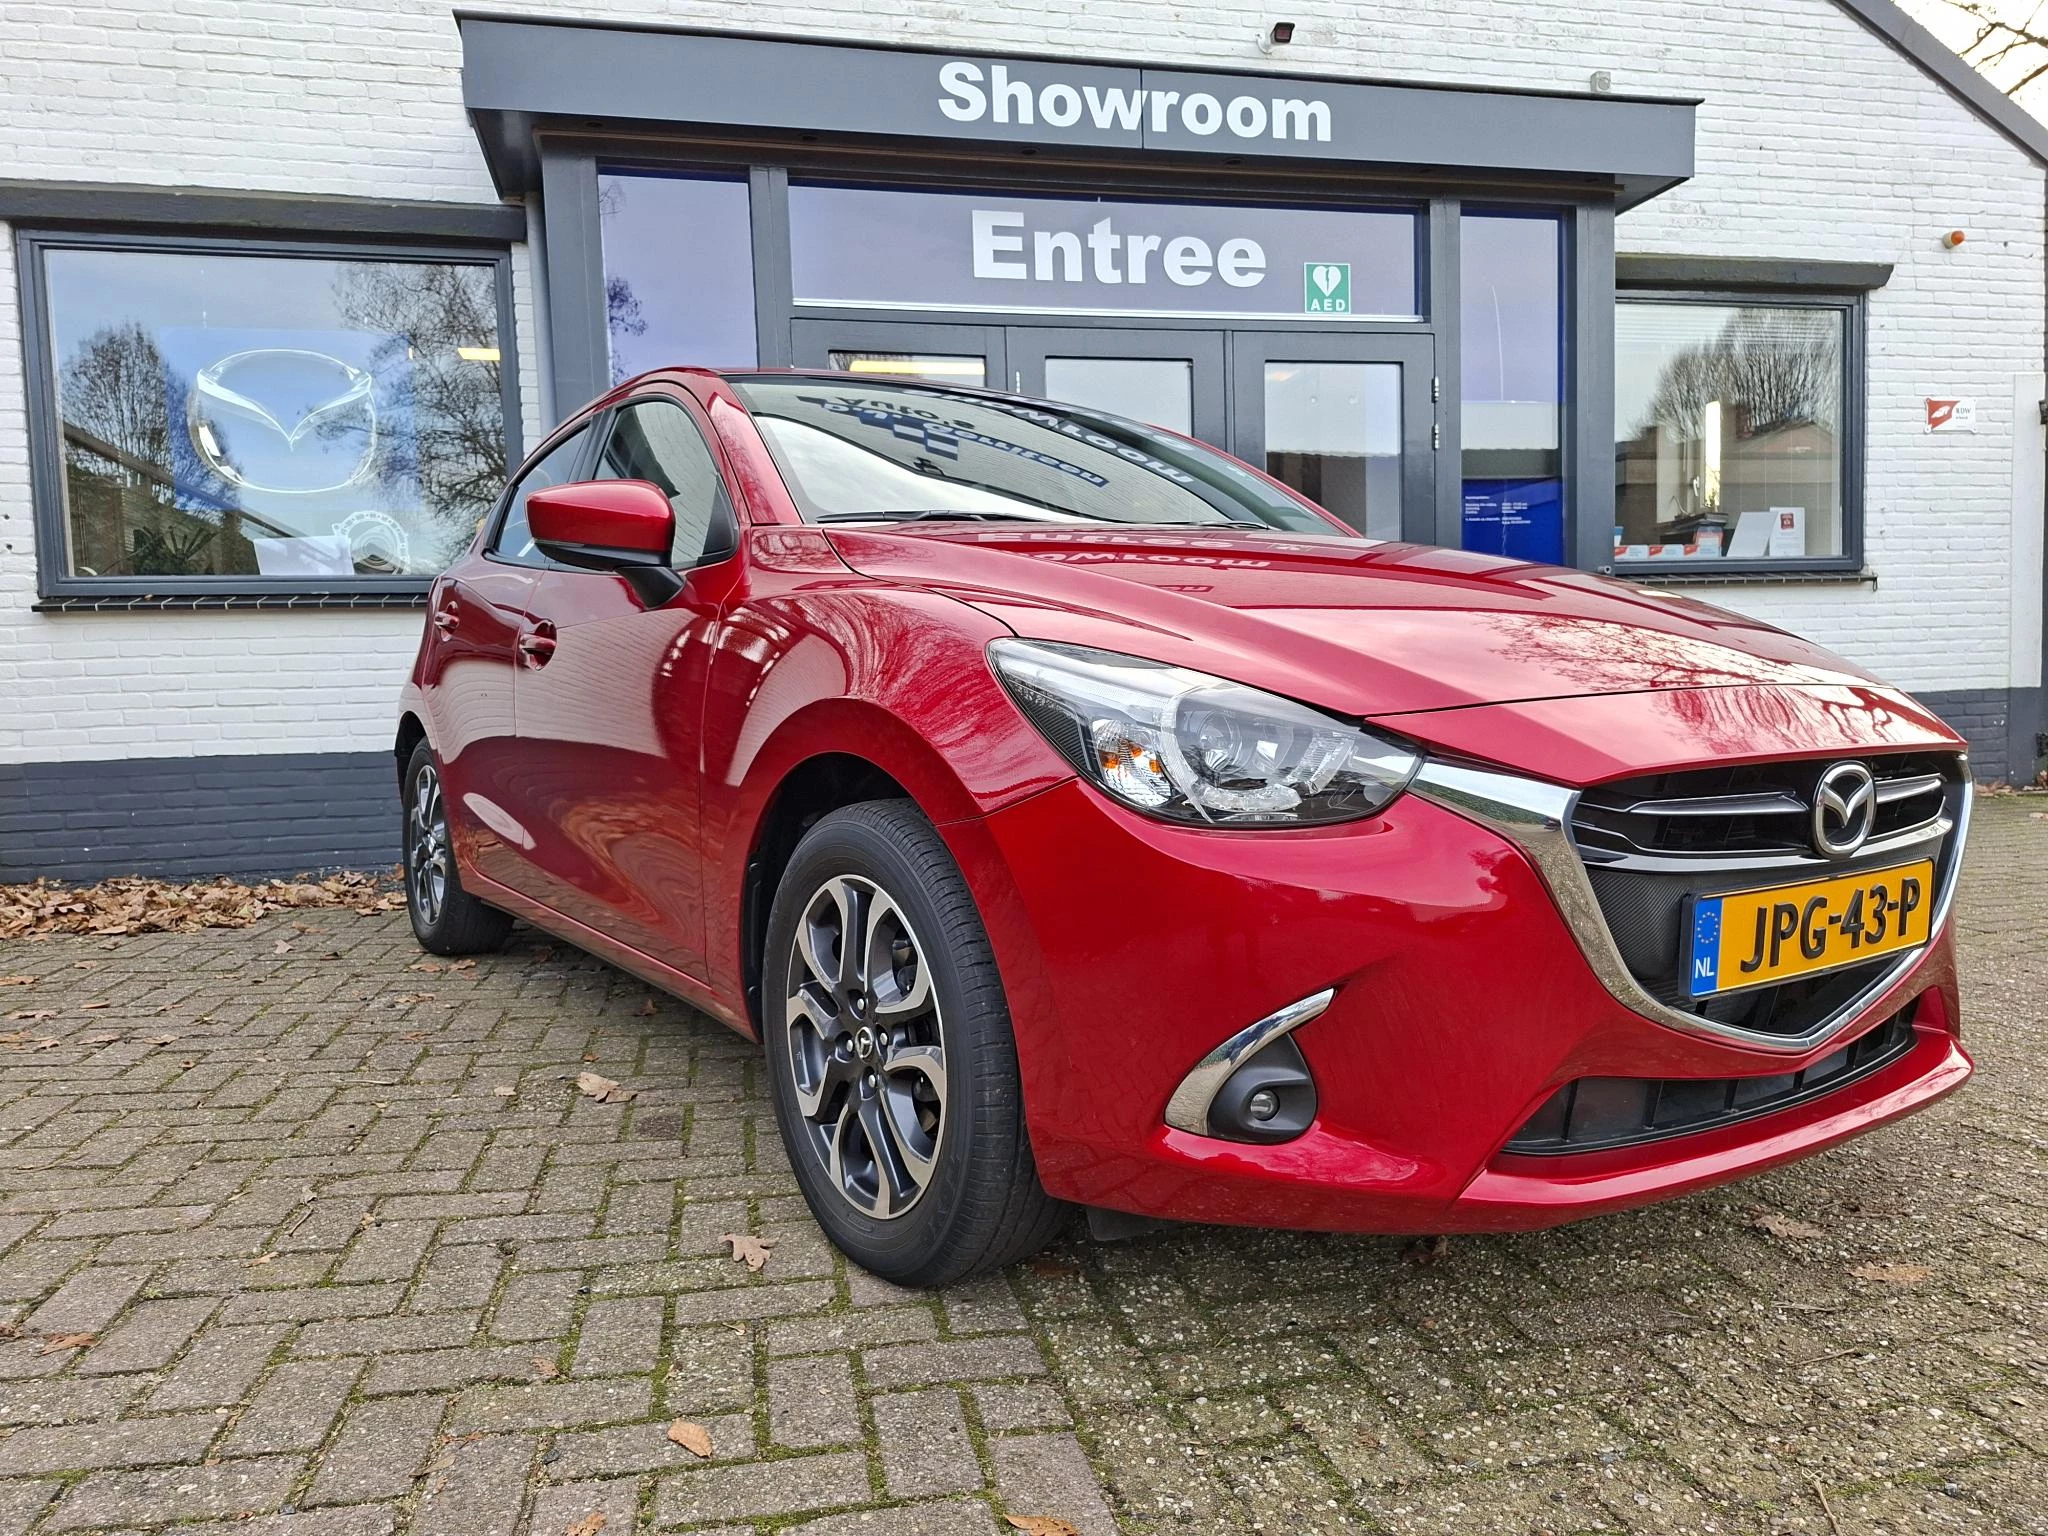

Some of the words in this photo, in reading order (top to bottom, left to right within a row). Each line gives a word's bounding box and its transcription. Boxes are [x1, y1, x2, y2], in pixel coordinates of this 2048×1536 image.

[938, 61, 1332, 142] Showroom
[971, 208, 1267, 288] Entree
[1310, 297, 1346, 312] AED
[1740, 878, 1922, 973] JPG-43-P
[1694, 958, 1715, 979] NL
